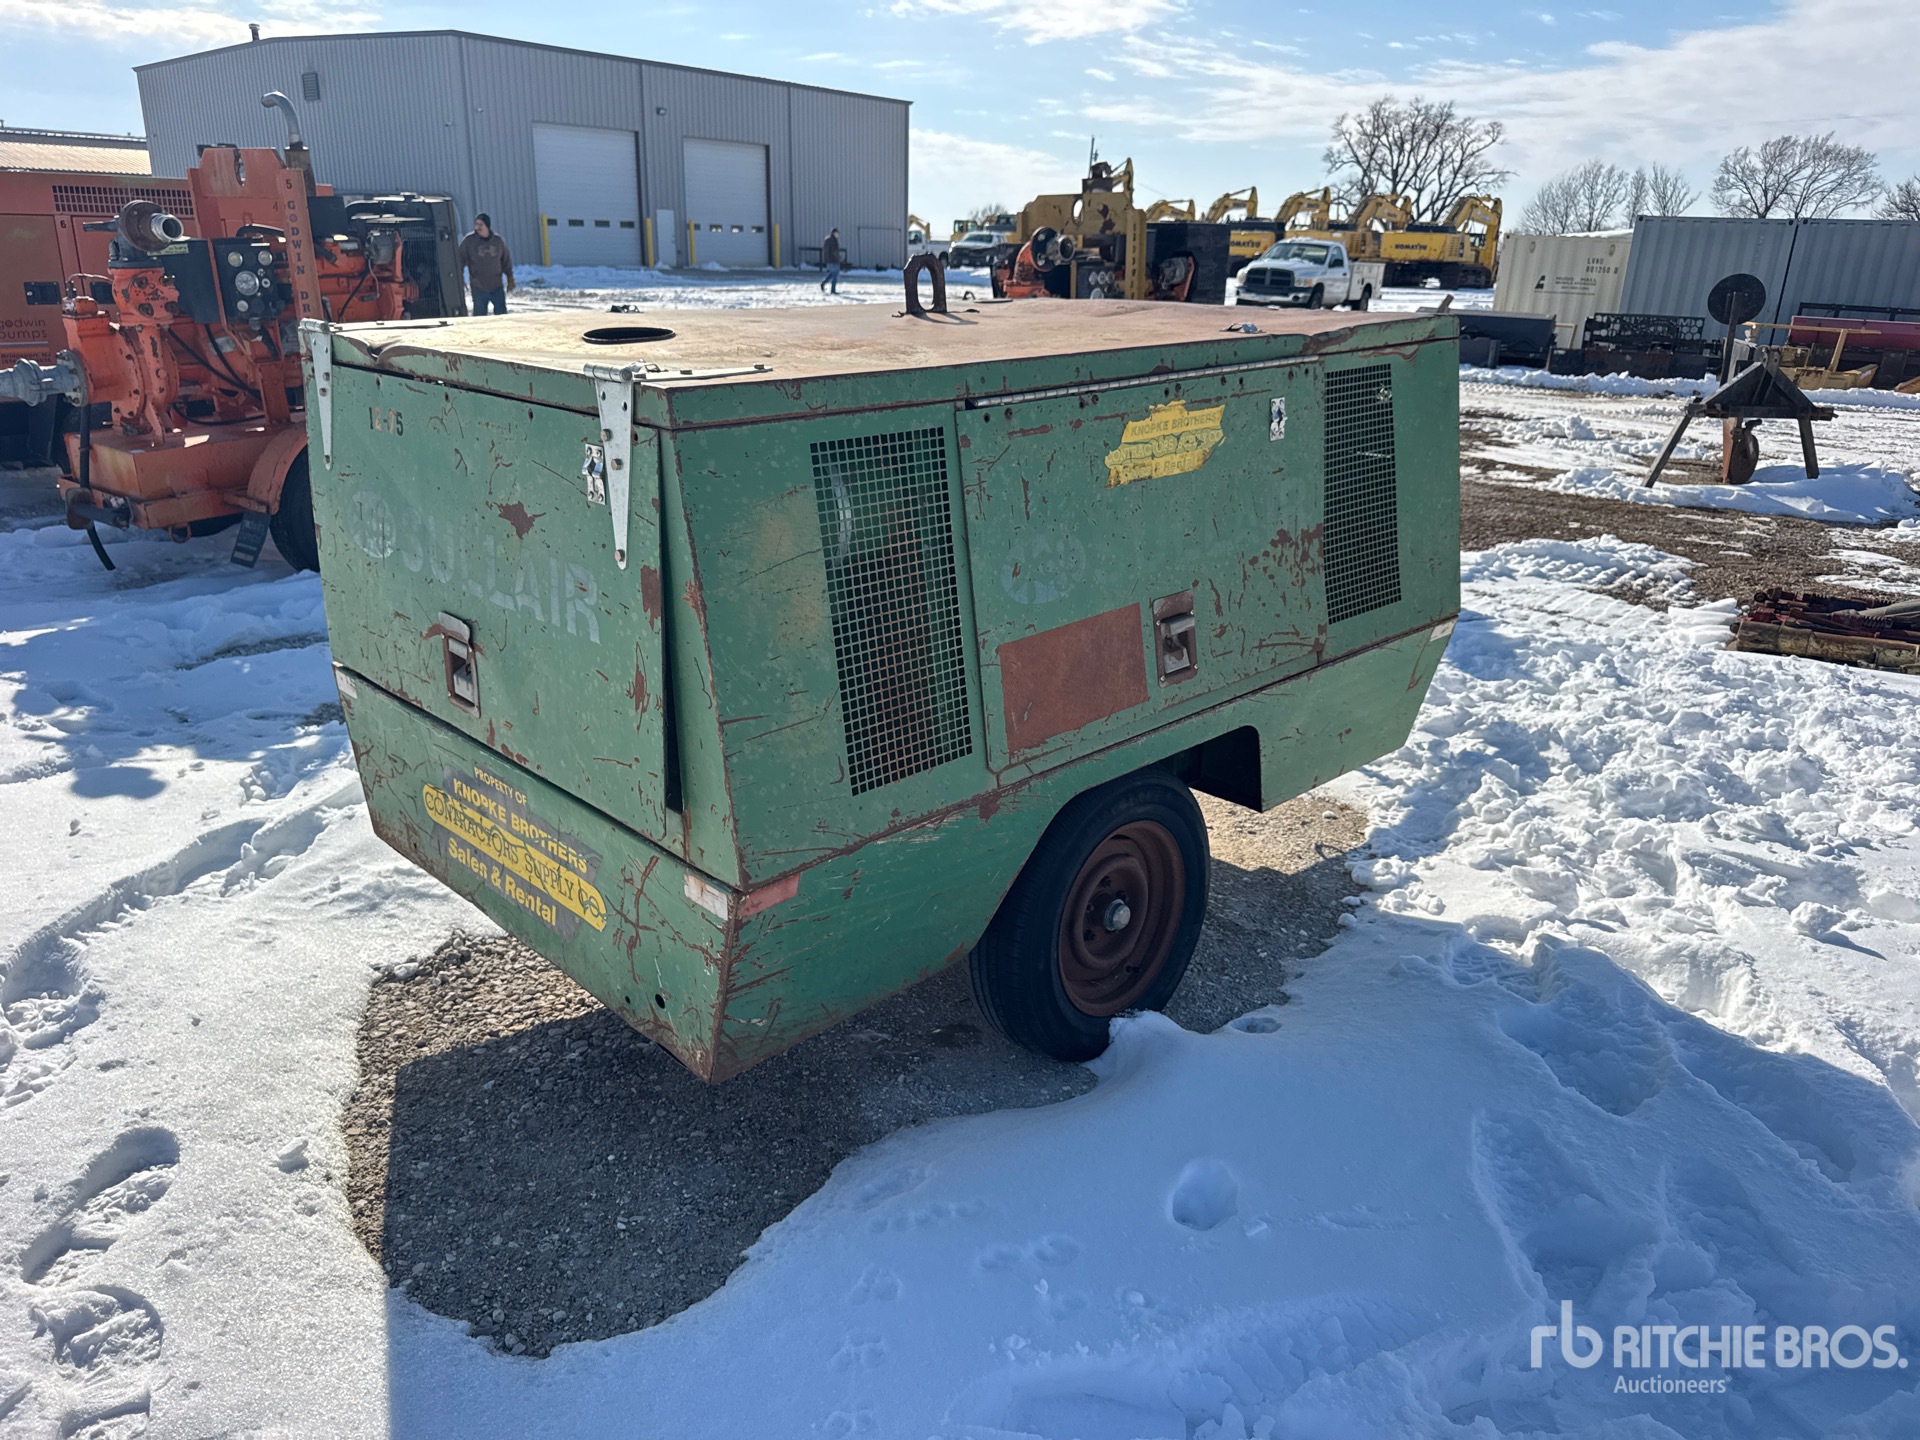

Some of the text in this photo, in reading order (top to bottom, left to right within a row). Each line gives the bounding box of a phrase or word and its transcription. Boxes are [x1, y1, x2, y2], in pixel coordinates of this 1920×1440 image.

[286, 179, 293, 189] 5
[60, 219, 67, 229] 6
[1230, 240, 1261, 248] OMATSU
[1394, 242, 1428, 251] KOMATSU
[1131, 412, 1217, 437] KNOPKE BROTHERS
[473, 767, 528, 806] PROPERTY OF
[453, 778, 588, 874] KNOPKE BROTHERS
[424, 791, 519, 865] CONTRACTORS
[524, 853, 575, 903] SUPPLY
[448, 837, 557, 926] Sales & Rental
